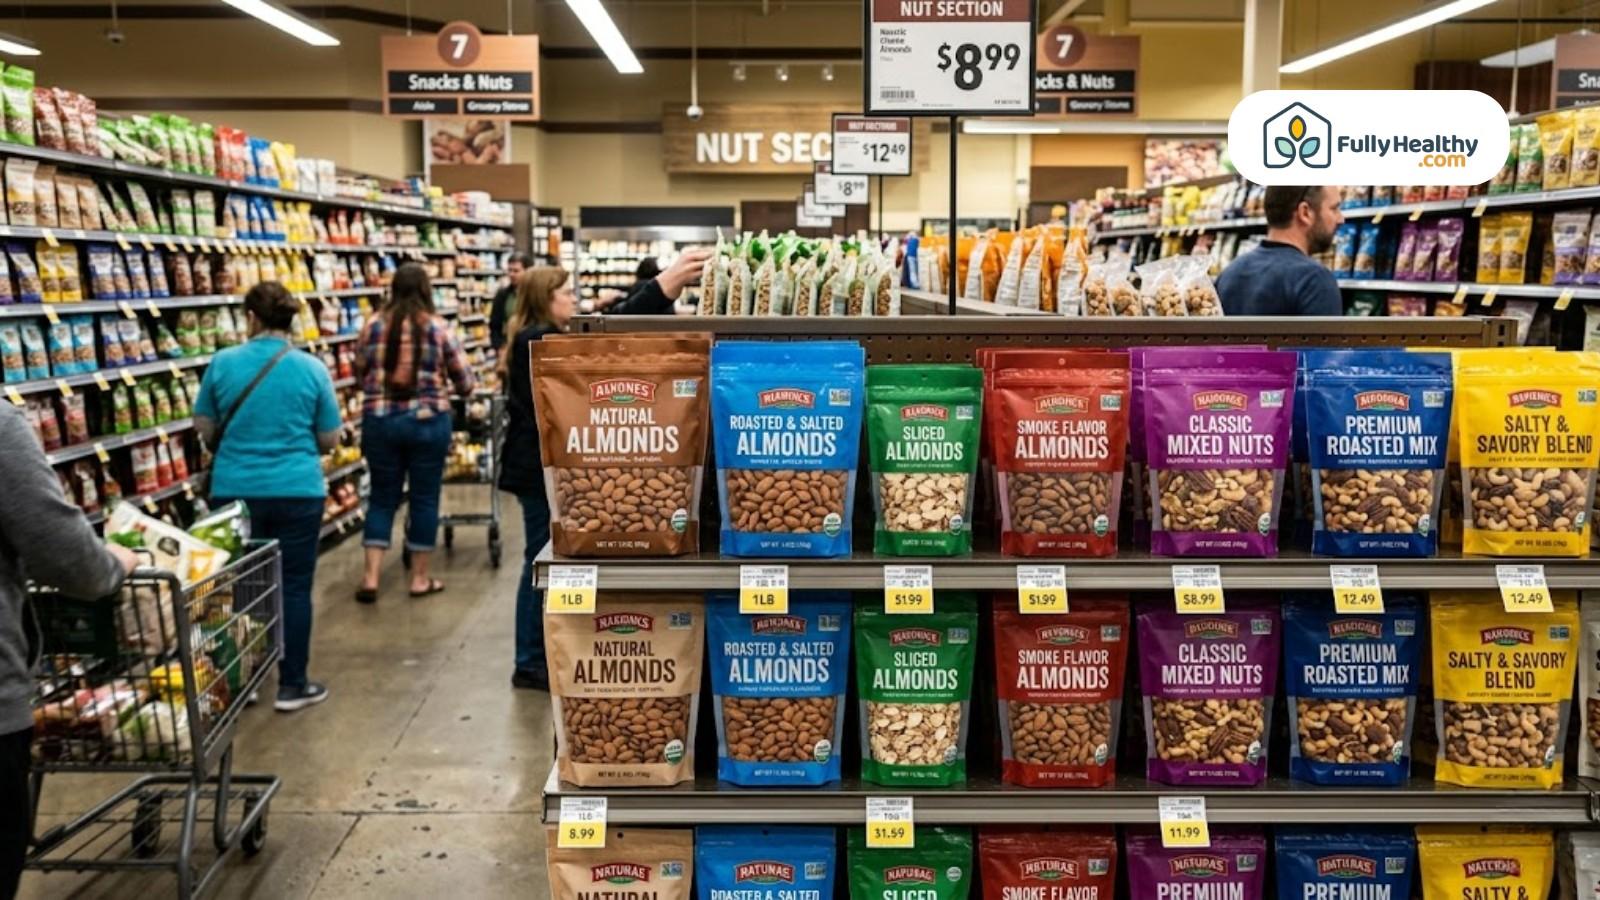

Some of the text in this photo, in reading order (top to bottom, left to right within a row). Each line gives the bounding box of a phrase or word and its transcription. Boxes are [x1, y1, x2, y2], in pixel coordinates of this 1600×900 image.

[901, 0, 1003, 17] NUT SECTION
[450, 34, 469, 59] 7
[1056, 34, 1073, 58] 7
[408, 74, 513, 91] Snacks & Nuts
[1066, 75, 1078, 90] &
[1081, 75, 1115, 90] Nuts
[697, 132, 763, 163] NUT
[590, 407, 656, 425] NATURAL
[730, 415, 843, 430] ROASTED & SALTED
[1189, 415, 1252, 433] CLASSIC
[1346, 415, 1421, 434] PREMIUM
[1504, 414, 1569, 433] SALTY &
[903, 426, 945, 441] SLICED
[1017, 420, 1107, 435] SMOKE FLAVOR
[567, 425, 679, 454] ALMONDS
[737, 431, 837, 457] ALMONDS
[1015, 435, 1109, 460] ALMONDS
[1168, 435, 1274, 456] MIXED NUTS
[1327, 435, 1438, 456] ROASTED MIX
[1477, 435, 1592, 454] SAVORY BLEND
[886, 442, 964, 461] ALMONDS
[561, 594, 583, 606] 1LB
[753, 594, 775, 606] 1LB
[1342, 593, 1376, 605] 12.49
[1510, 592, 1543, 604] 12.49
[593, 641, 655, 658] NATURAL
[724, 642, 834, 656] ROASTED & SALTED
[1018, 650, 1109, 665] SMOKE FLAVOR
[1178, 643, 1247, 663] CLASSIC
[1319, 643, 1397, 663] PREMIUM
[894, 652, 938, 667] SLICED
[1448, 651, 1567, 669] SALTY & SAVORY
[573, 658, 676, 684] ALMONDS
[729, 658, 830, 684] ALMONDS
[873, 668, 958, 690] ALMONDS
[1016, 667, 1109, 689] ALMONDS
[1162, 665, 1263, 685] MIXED NUTS
[1304, 664, 1409, 685] ROASTED MIX
[1485, 671, 1535, 689] BLEND
[569, 827, 595, 840] 8.99
[1169, 827, 1200, 839] 11.99
[1002, 886, 1098, 900] SMOKE FLAVOR
[1157, 882, 1244, 900] PREMIUM
[1303, 882, 1391, 900] PREMIUM
[1462, 886, 1529, 900] SALTY &
